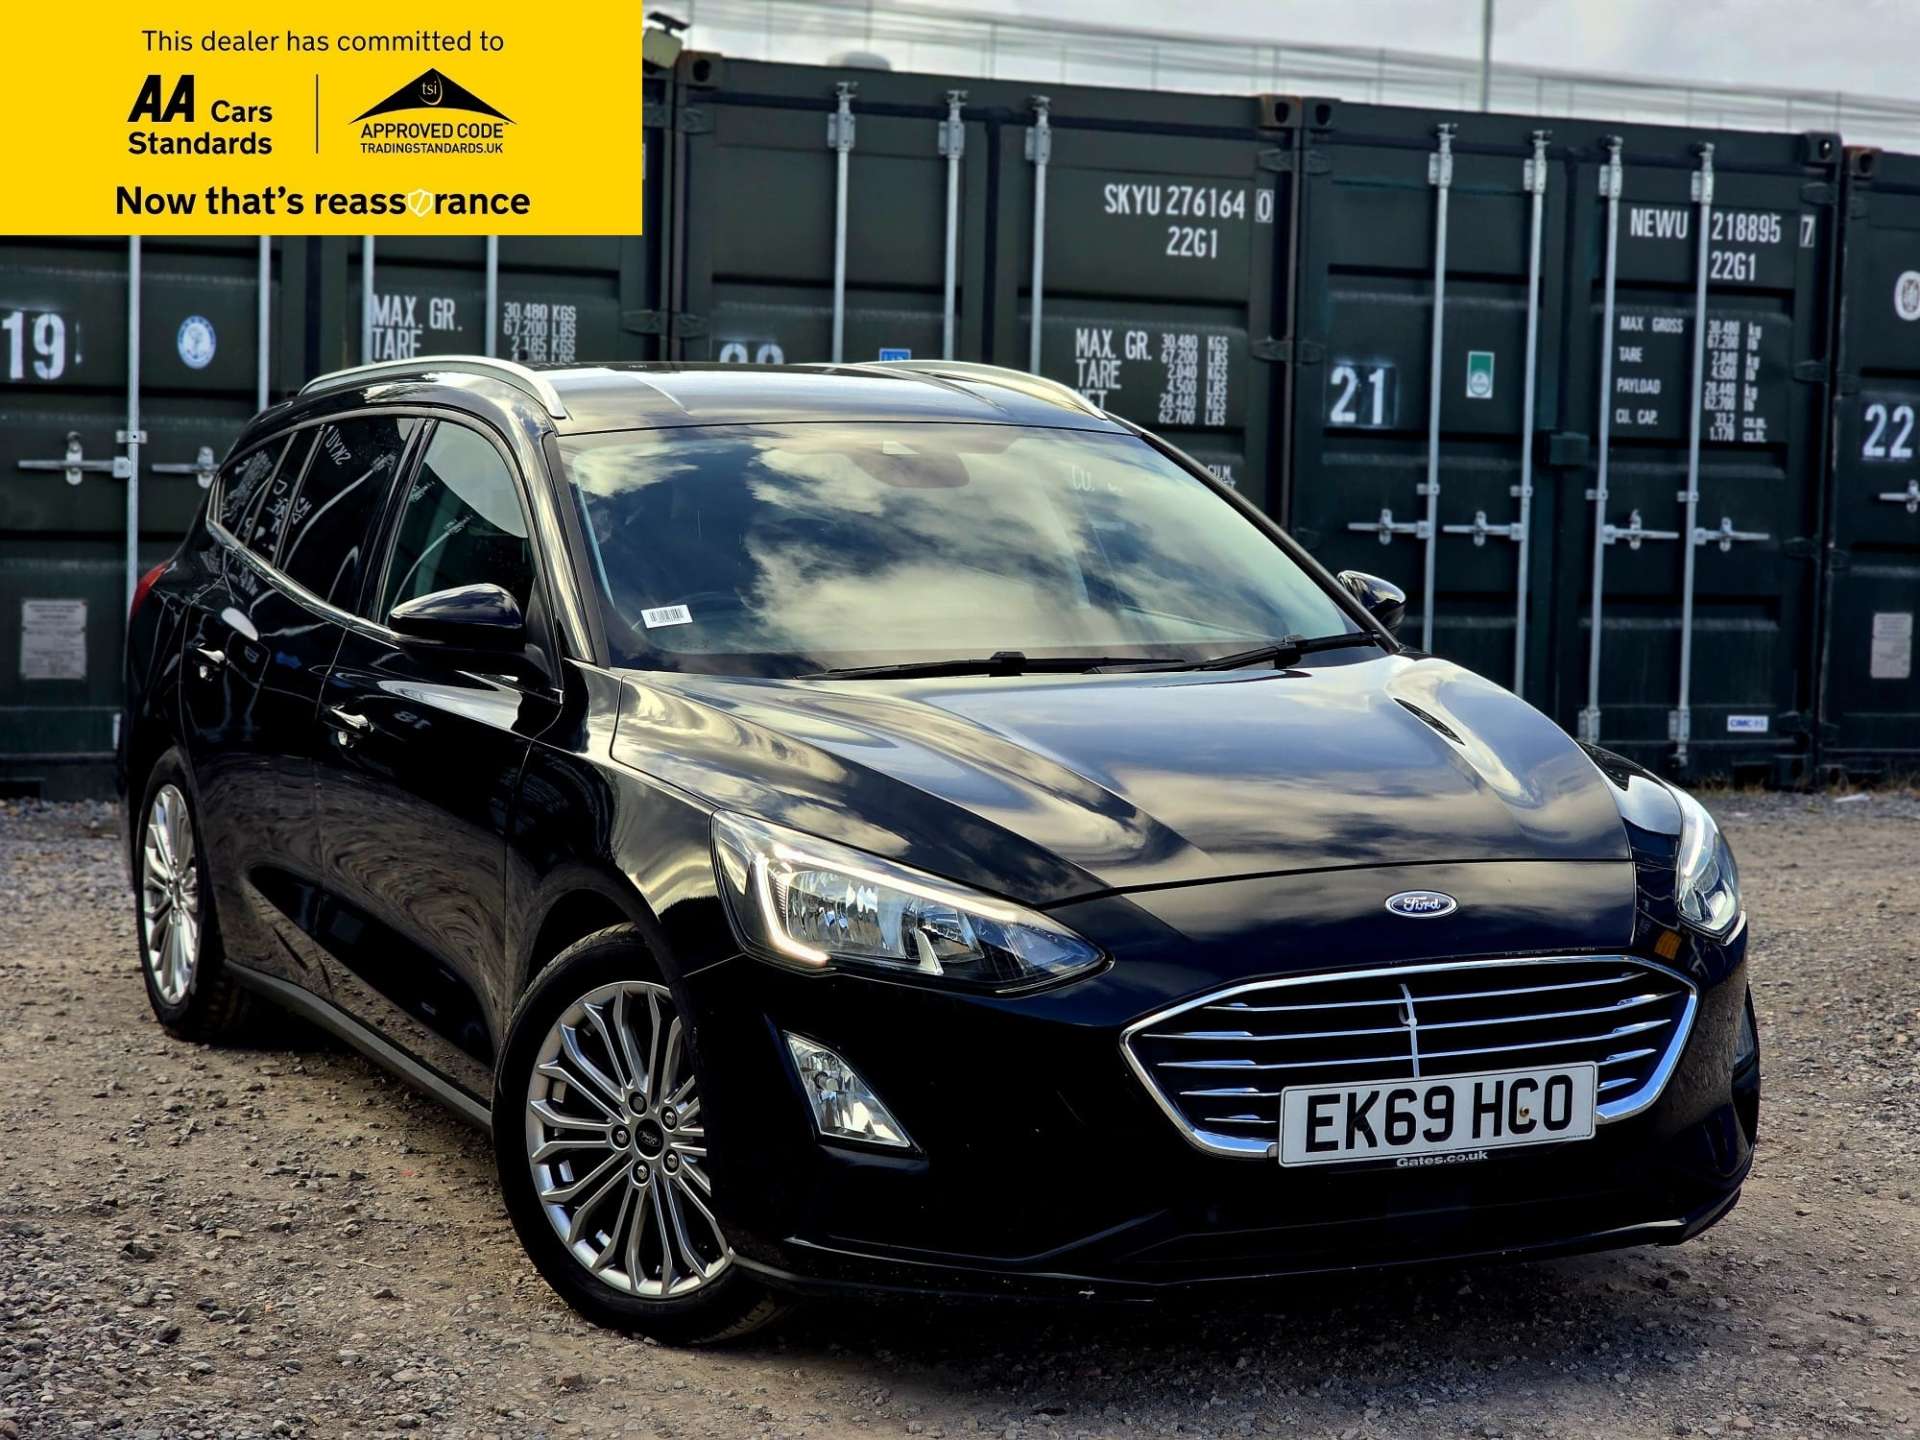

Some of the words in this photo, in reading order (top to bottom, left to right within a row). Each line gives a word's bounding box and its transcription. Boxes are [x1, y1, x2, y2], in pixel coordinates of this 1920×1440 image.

[1104, 183, 1160, 216] SKYU
[1165, 185, 1246, 220] 276164
[1166, 225, 1218, 259] 22G1
[1630, 207, 1689, 240] NEWU
[1711, 211, 1781, 244] 218895
[1710, 250, 1756, 281] 22G1
[429, 297, 463, 332] GR.
[2, 311, 66, 380] 19
[1075, 327, 1116, 359] MAX.
[1124, 331, 1152, 361] GR.
[1075, 359, 1122, 389] TARE
[1330, 366, 1385, 425] 21
[1862, 403, 1915, 459] 22
[1403, 896, 1441, 911] Ford
[1305, 1085, 1455, 1153] EK69
[1472, 1074, 1574, 1139] HCO
[1396, 1151, 1489, 1168] Gates.co.uk
